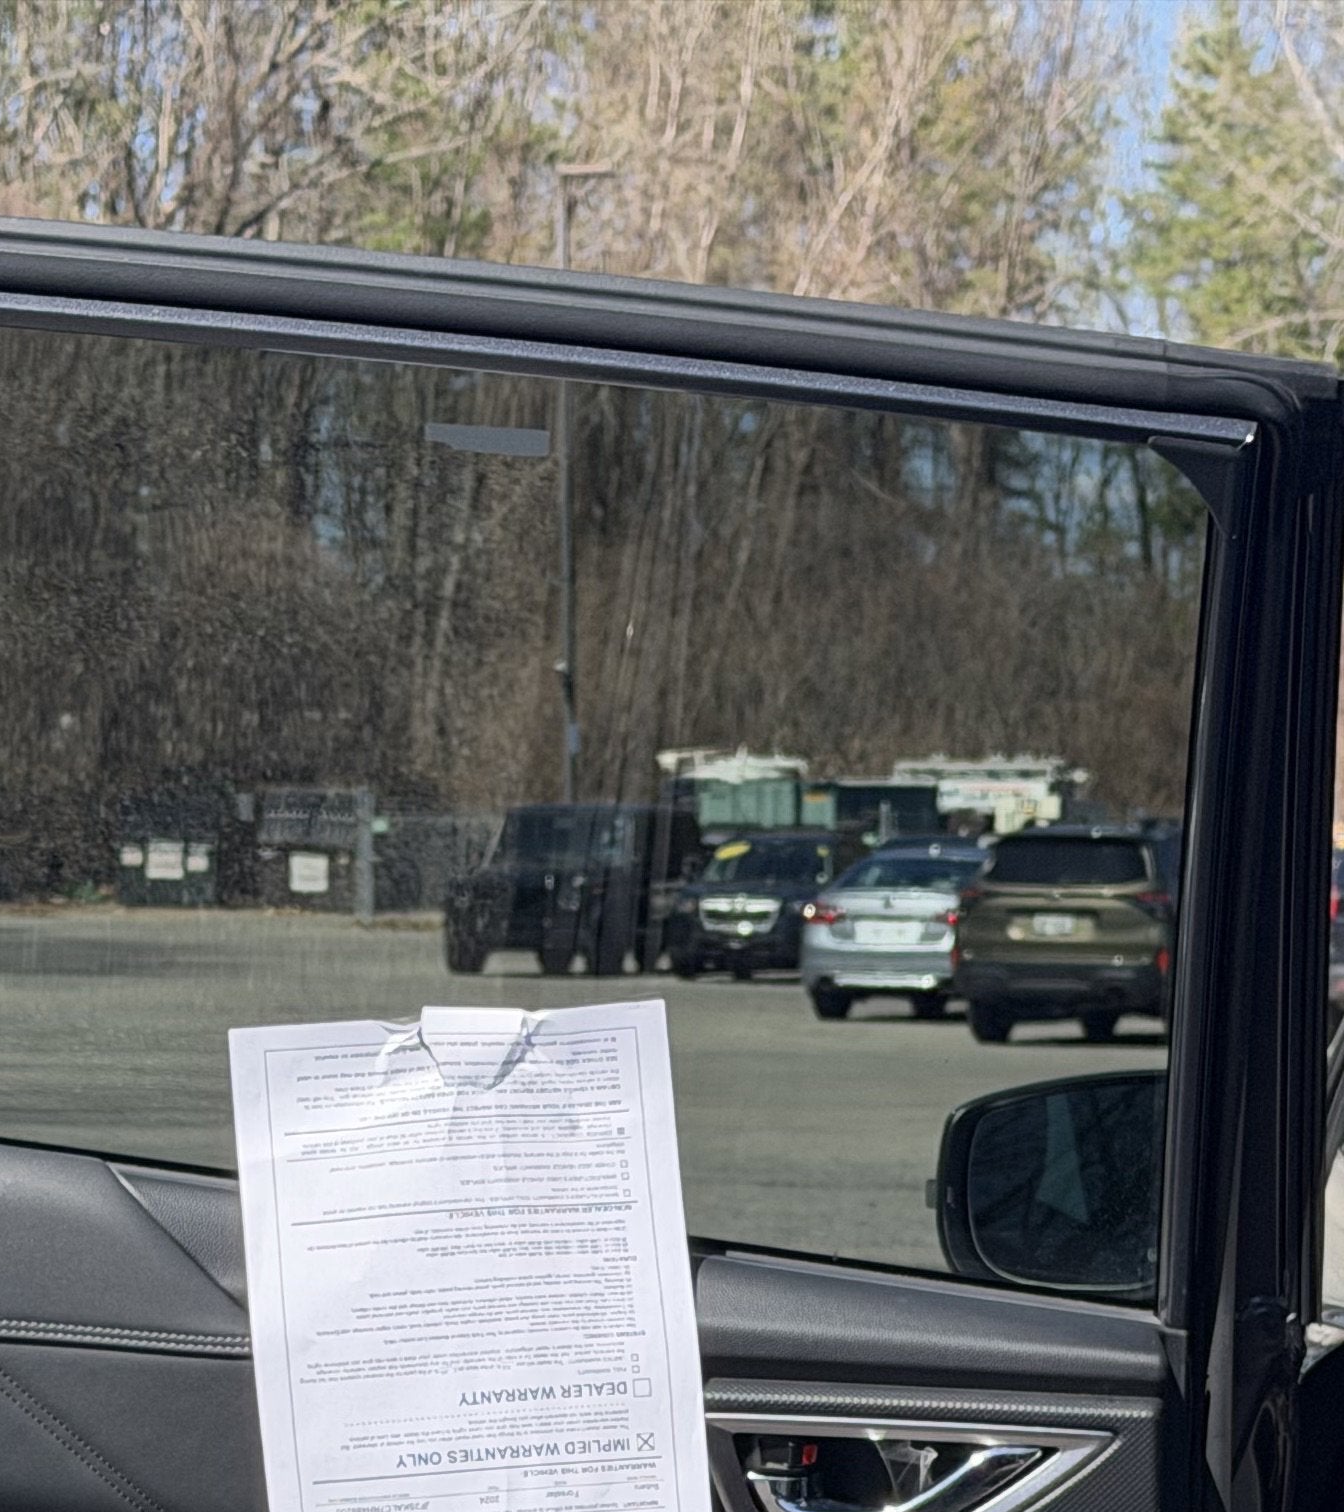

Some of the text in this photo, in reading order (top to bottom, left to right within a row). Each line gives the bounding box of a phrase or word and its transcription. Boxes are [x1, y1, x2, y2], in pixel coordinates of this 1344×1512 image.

[457, 1380, 627, 1406] DEALER WARRANTY
[395, 1437, 630, 1468] IMPLIED WARRANTIES ONLY
[581, 1465, 598, 1473] FOR
[479, 1495, 499, 1504] 2024
[545, 1489, 579, 1500] Forester
